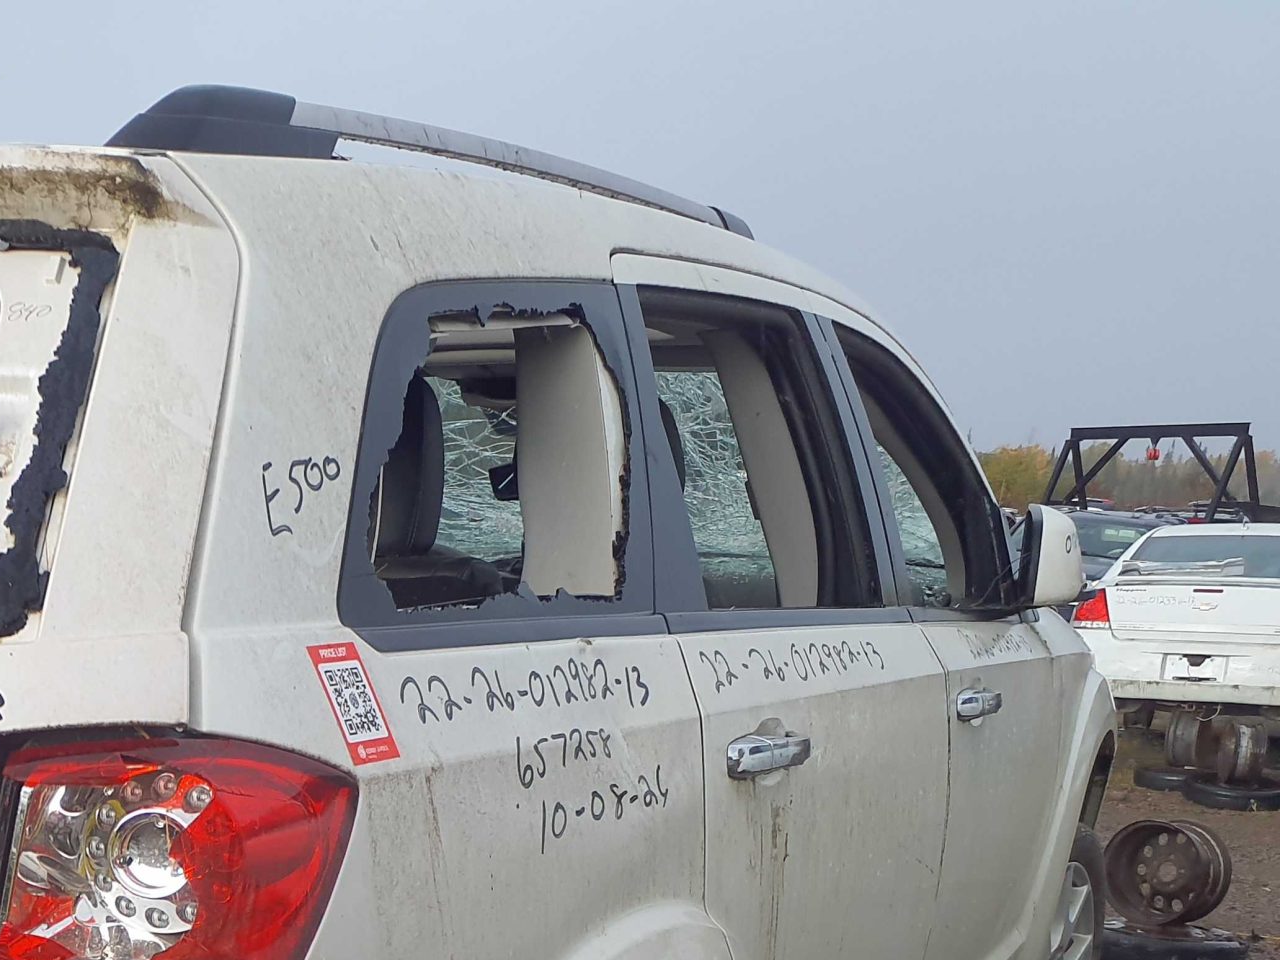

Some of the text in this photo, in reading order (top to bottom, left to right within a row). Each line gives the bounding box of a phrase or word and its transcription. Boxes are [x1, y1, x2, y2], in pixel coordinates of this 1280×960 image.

[261, 455, 341, 537] E500
[399, 657, 650, 725] 22-26-012982-13
[515, 727, 612, 789] 657258
